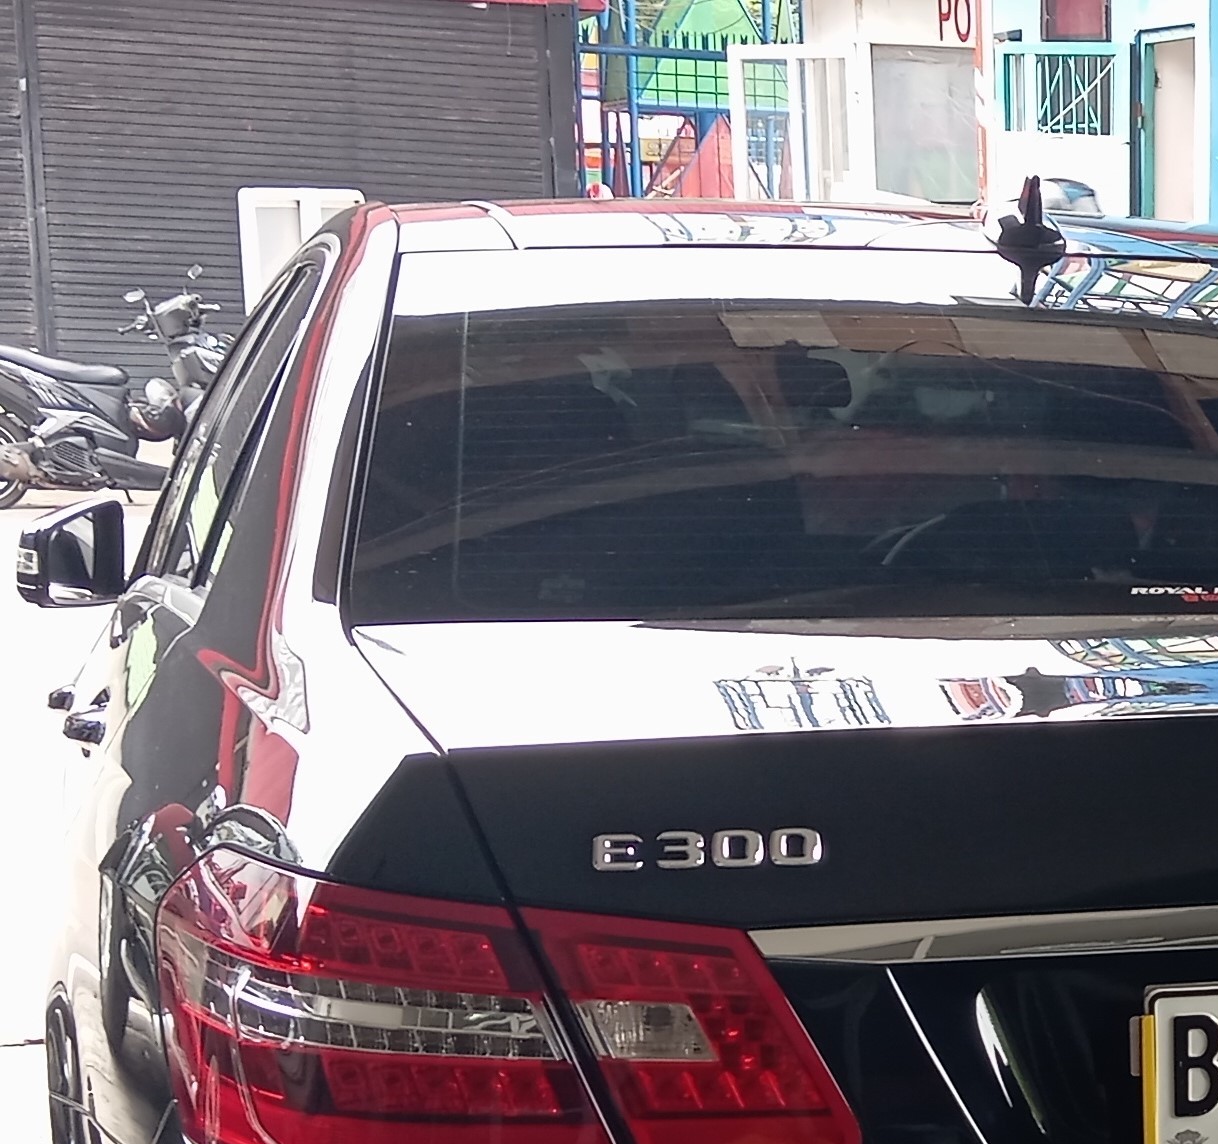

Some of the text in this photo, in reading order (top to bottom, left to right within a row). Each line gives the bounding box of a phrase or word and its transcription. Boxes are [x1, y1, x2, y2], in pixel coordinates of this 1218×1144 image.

[1130, 587, 1208, 595] ROYAL
[592, 828, 823, 871] E 300
